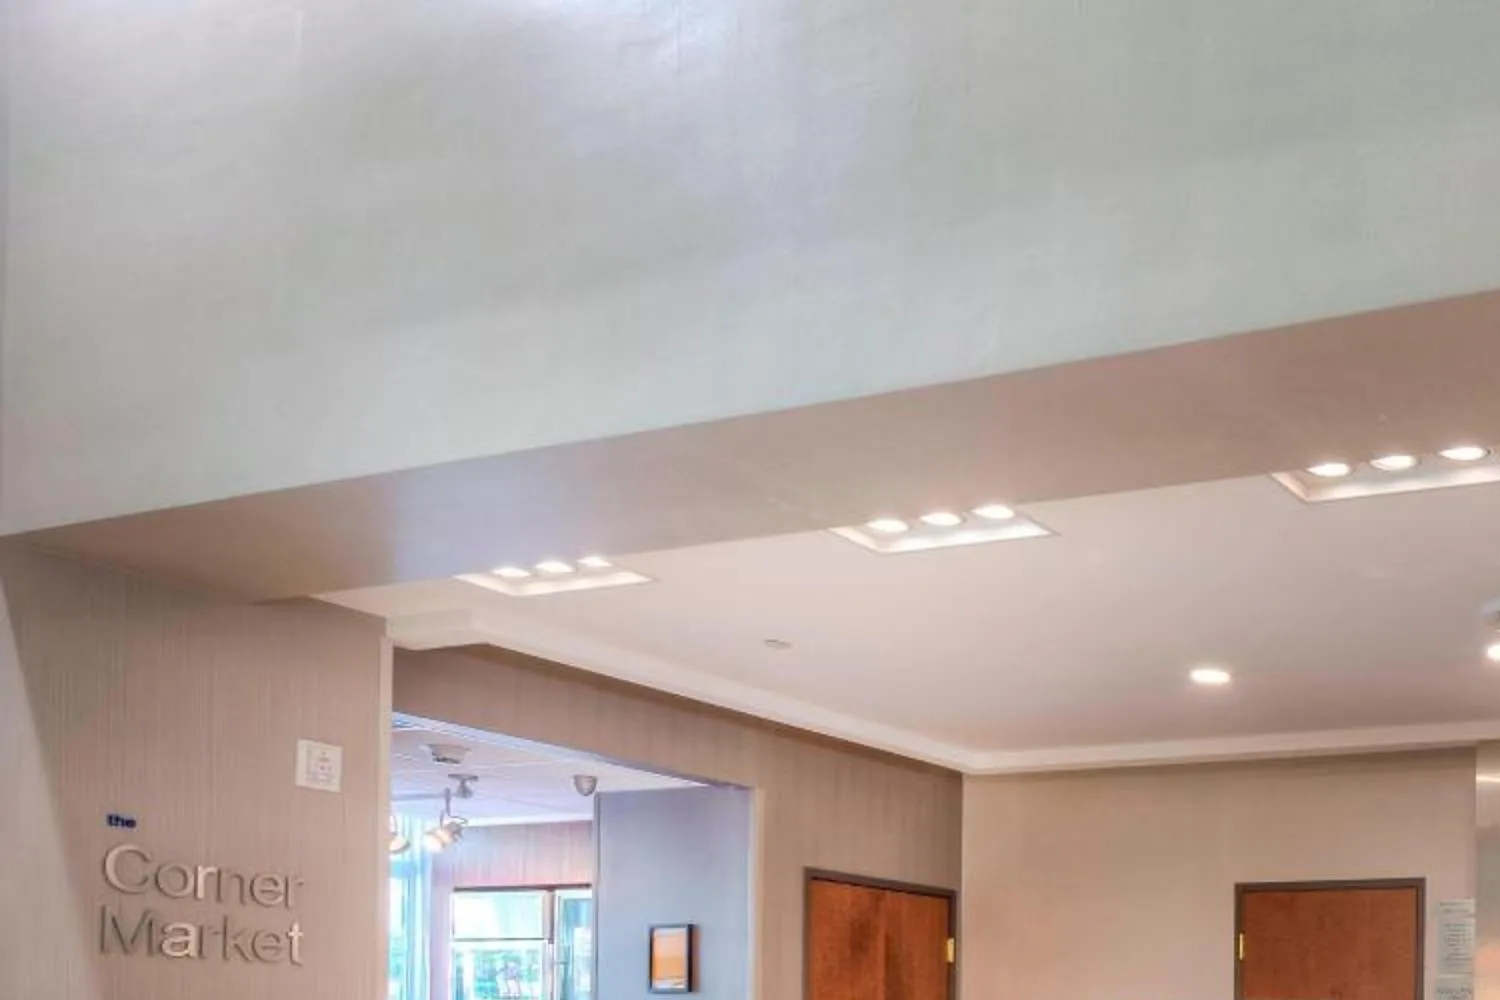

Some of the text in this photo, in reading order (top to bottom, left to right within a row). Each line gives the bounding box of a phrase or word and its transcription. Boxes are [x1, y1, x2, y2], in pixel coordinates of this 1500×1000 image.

[106, 813, 137, 829] the
[102, 843, 304, 909] Corner
[99, 903, 303, 967] Market
